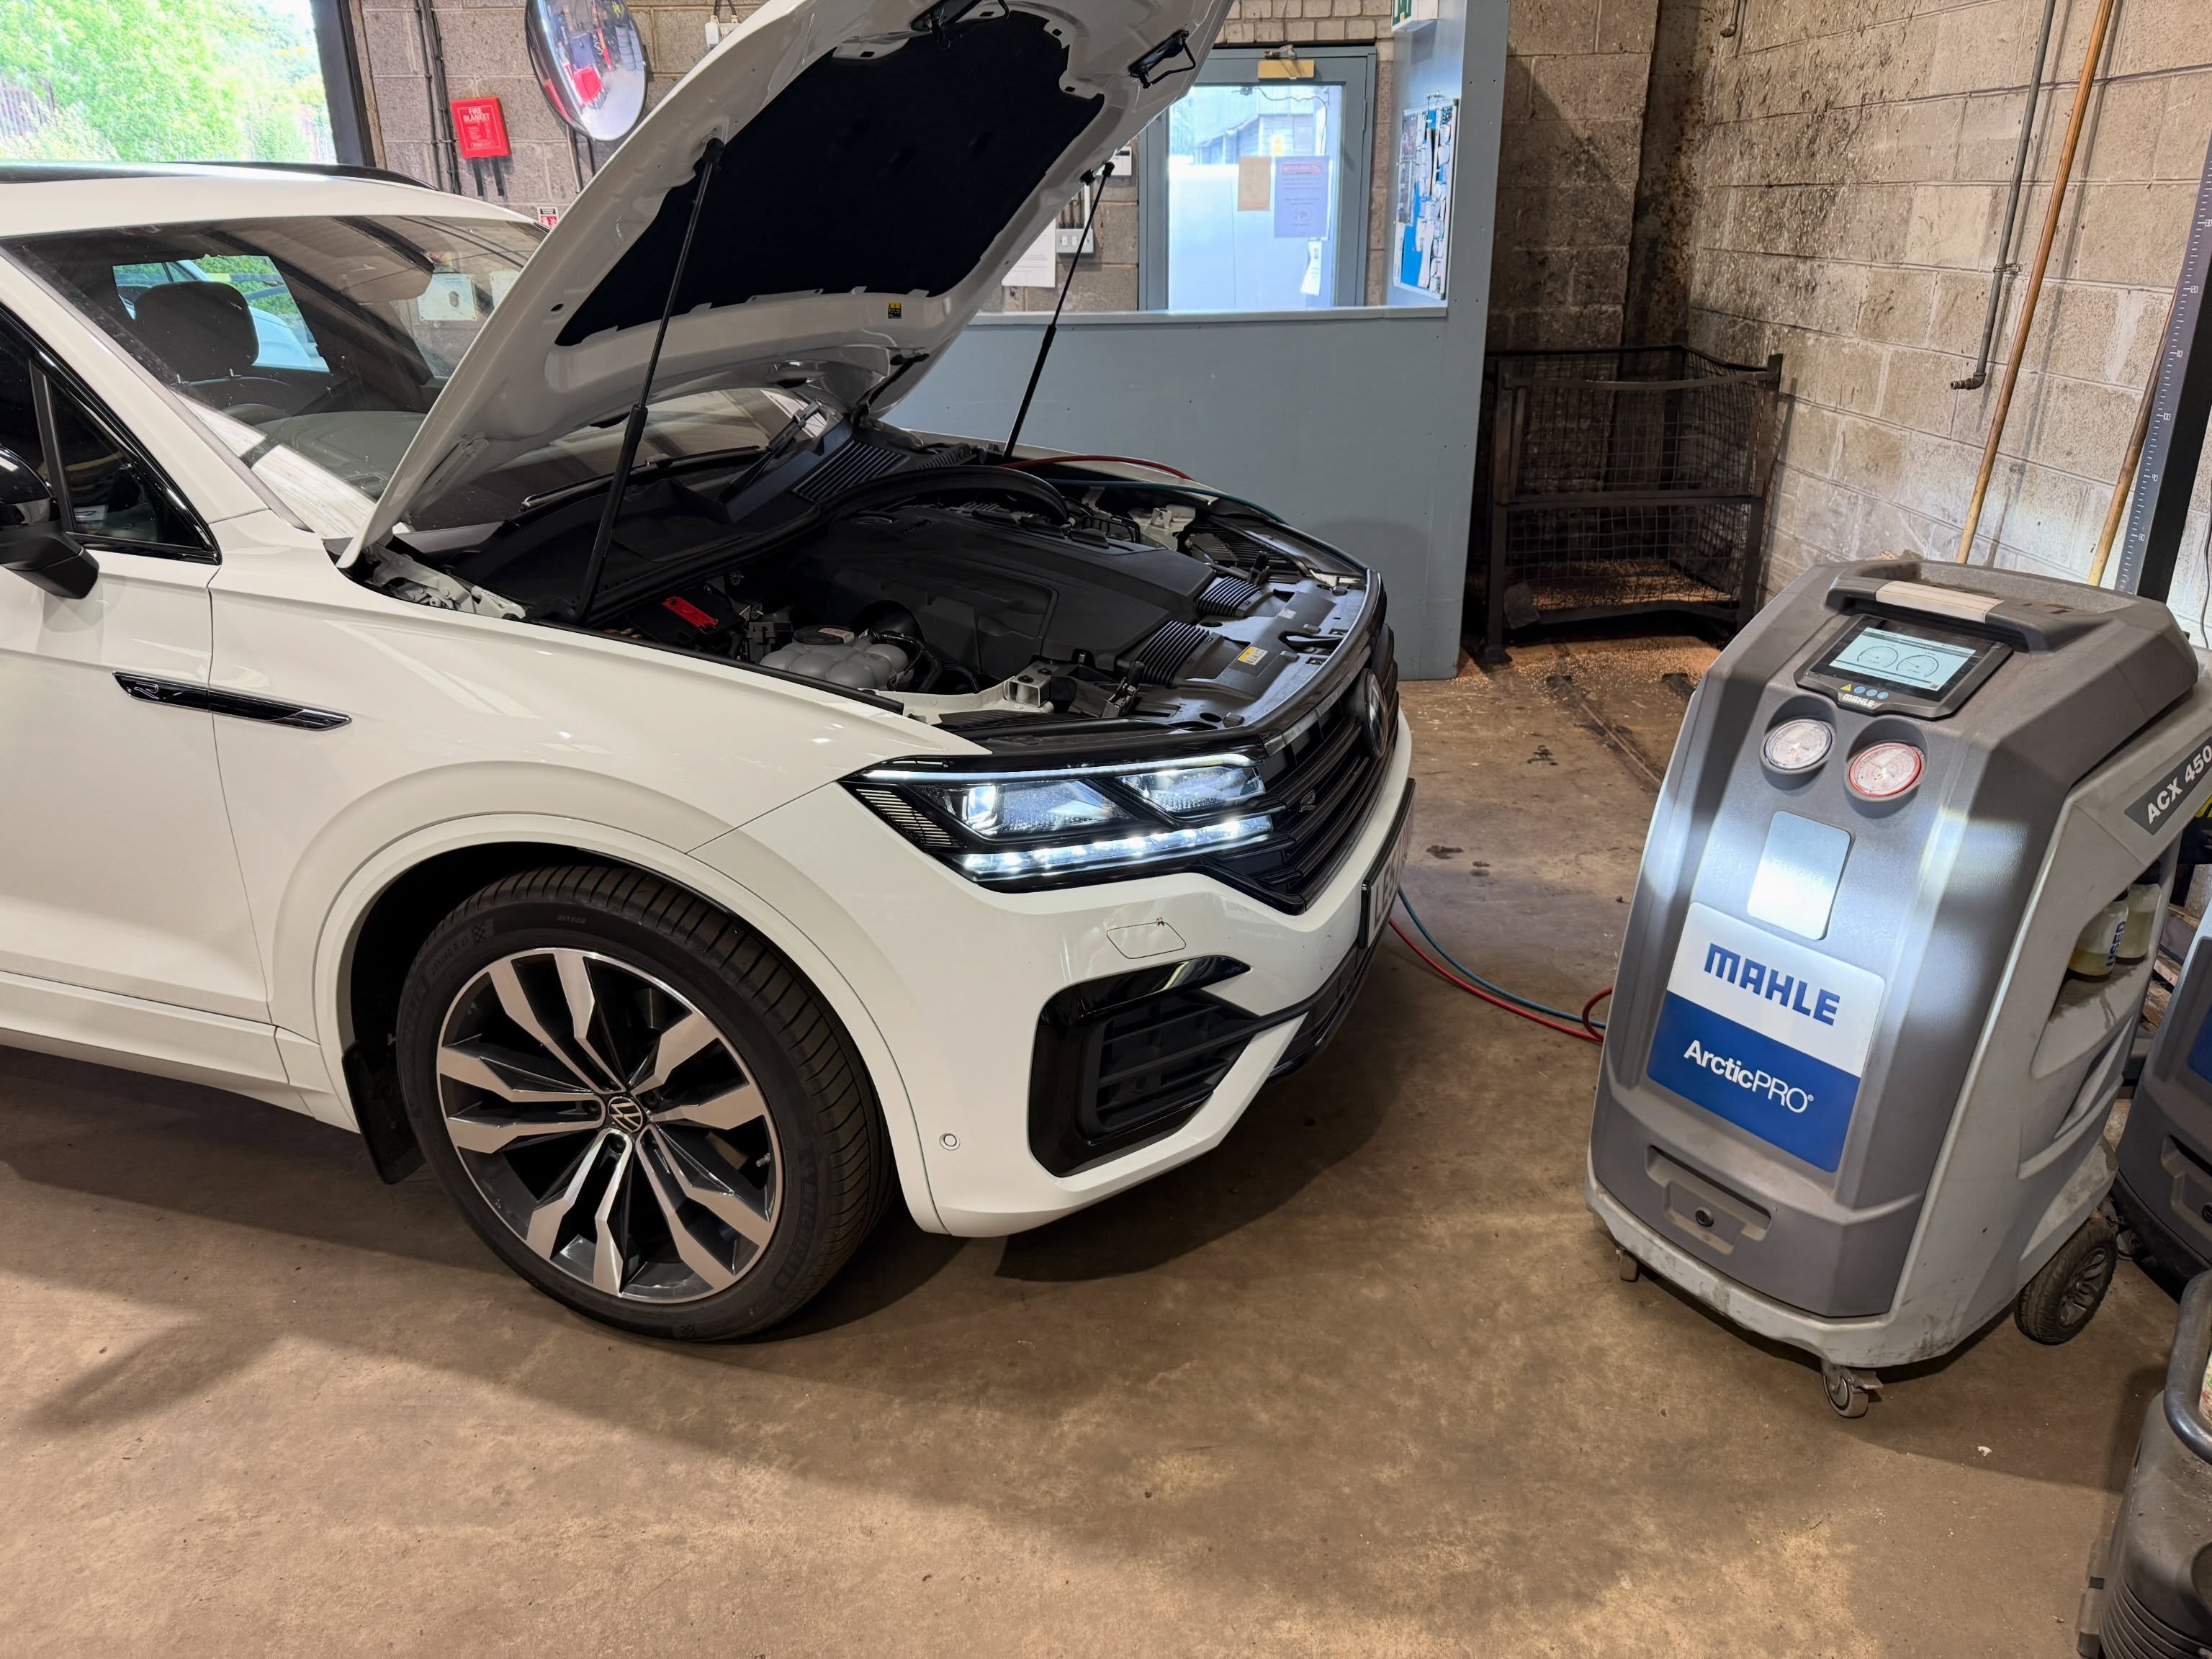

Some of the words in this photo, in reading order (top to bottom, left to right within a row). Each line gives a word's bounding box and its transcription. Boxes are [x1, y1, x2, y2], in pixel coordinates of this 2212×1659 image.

[463, 113, 490, 123] BLANKET
[468, 107, 482, 116] FIRE
[2152, 473, 2159, 482] 90
[1843, 693, 1875, 708] MAHLE
[2148, 777, 2183, 824] ACX
[2185, 745, 2212, 783] 450
[2106, 921, 2126, 966] USED
[1704, 943, 1840, 1026] MAHLE
